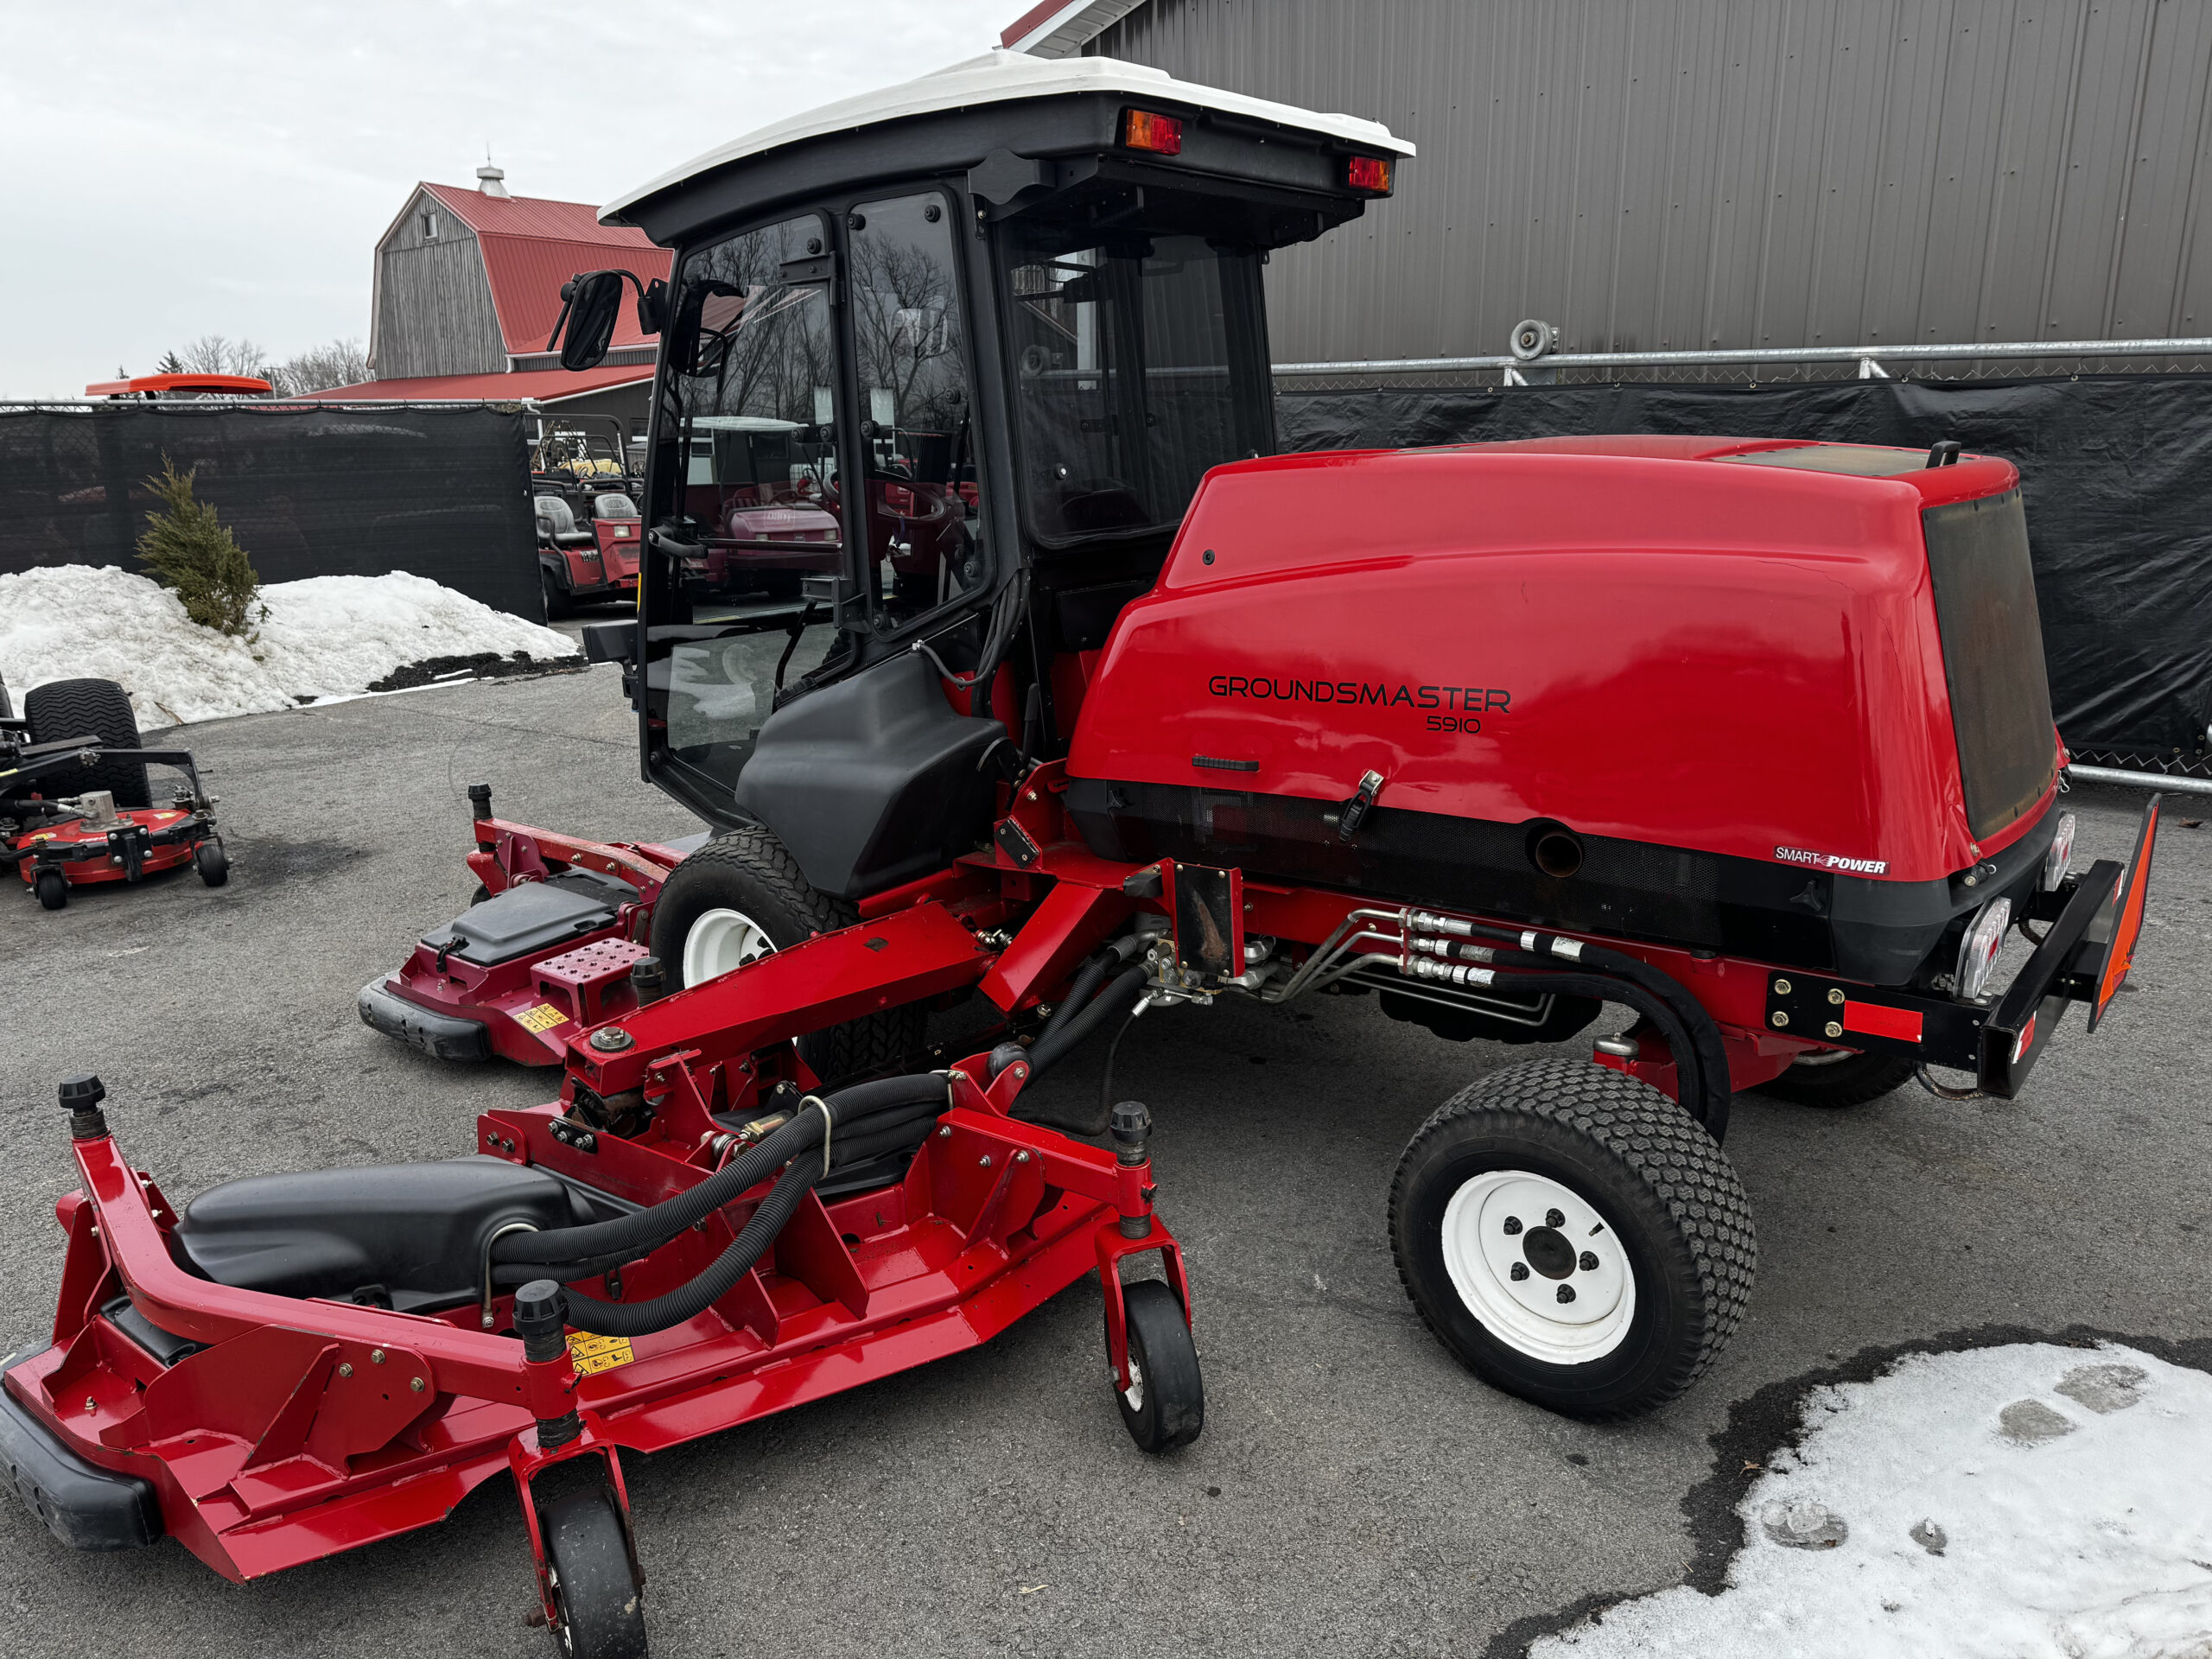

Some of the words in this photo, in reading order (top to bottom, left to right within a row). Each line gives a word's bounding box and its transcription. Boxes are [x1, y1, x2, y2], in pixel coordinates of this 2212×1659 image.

[1209, 675, 1511, 714] GROUNDSMASTER
[1427, 715, 1481, 734] 5910
[1775, 847, 1820, 865] SMART
[1827, 855, 1886, 874] POWER
